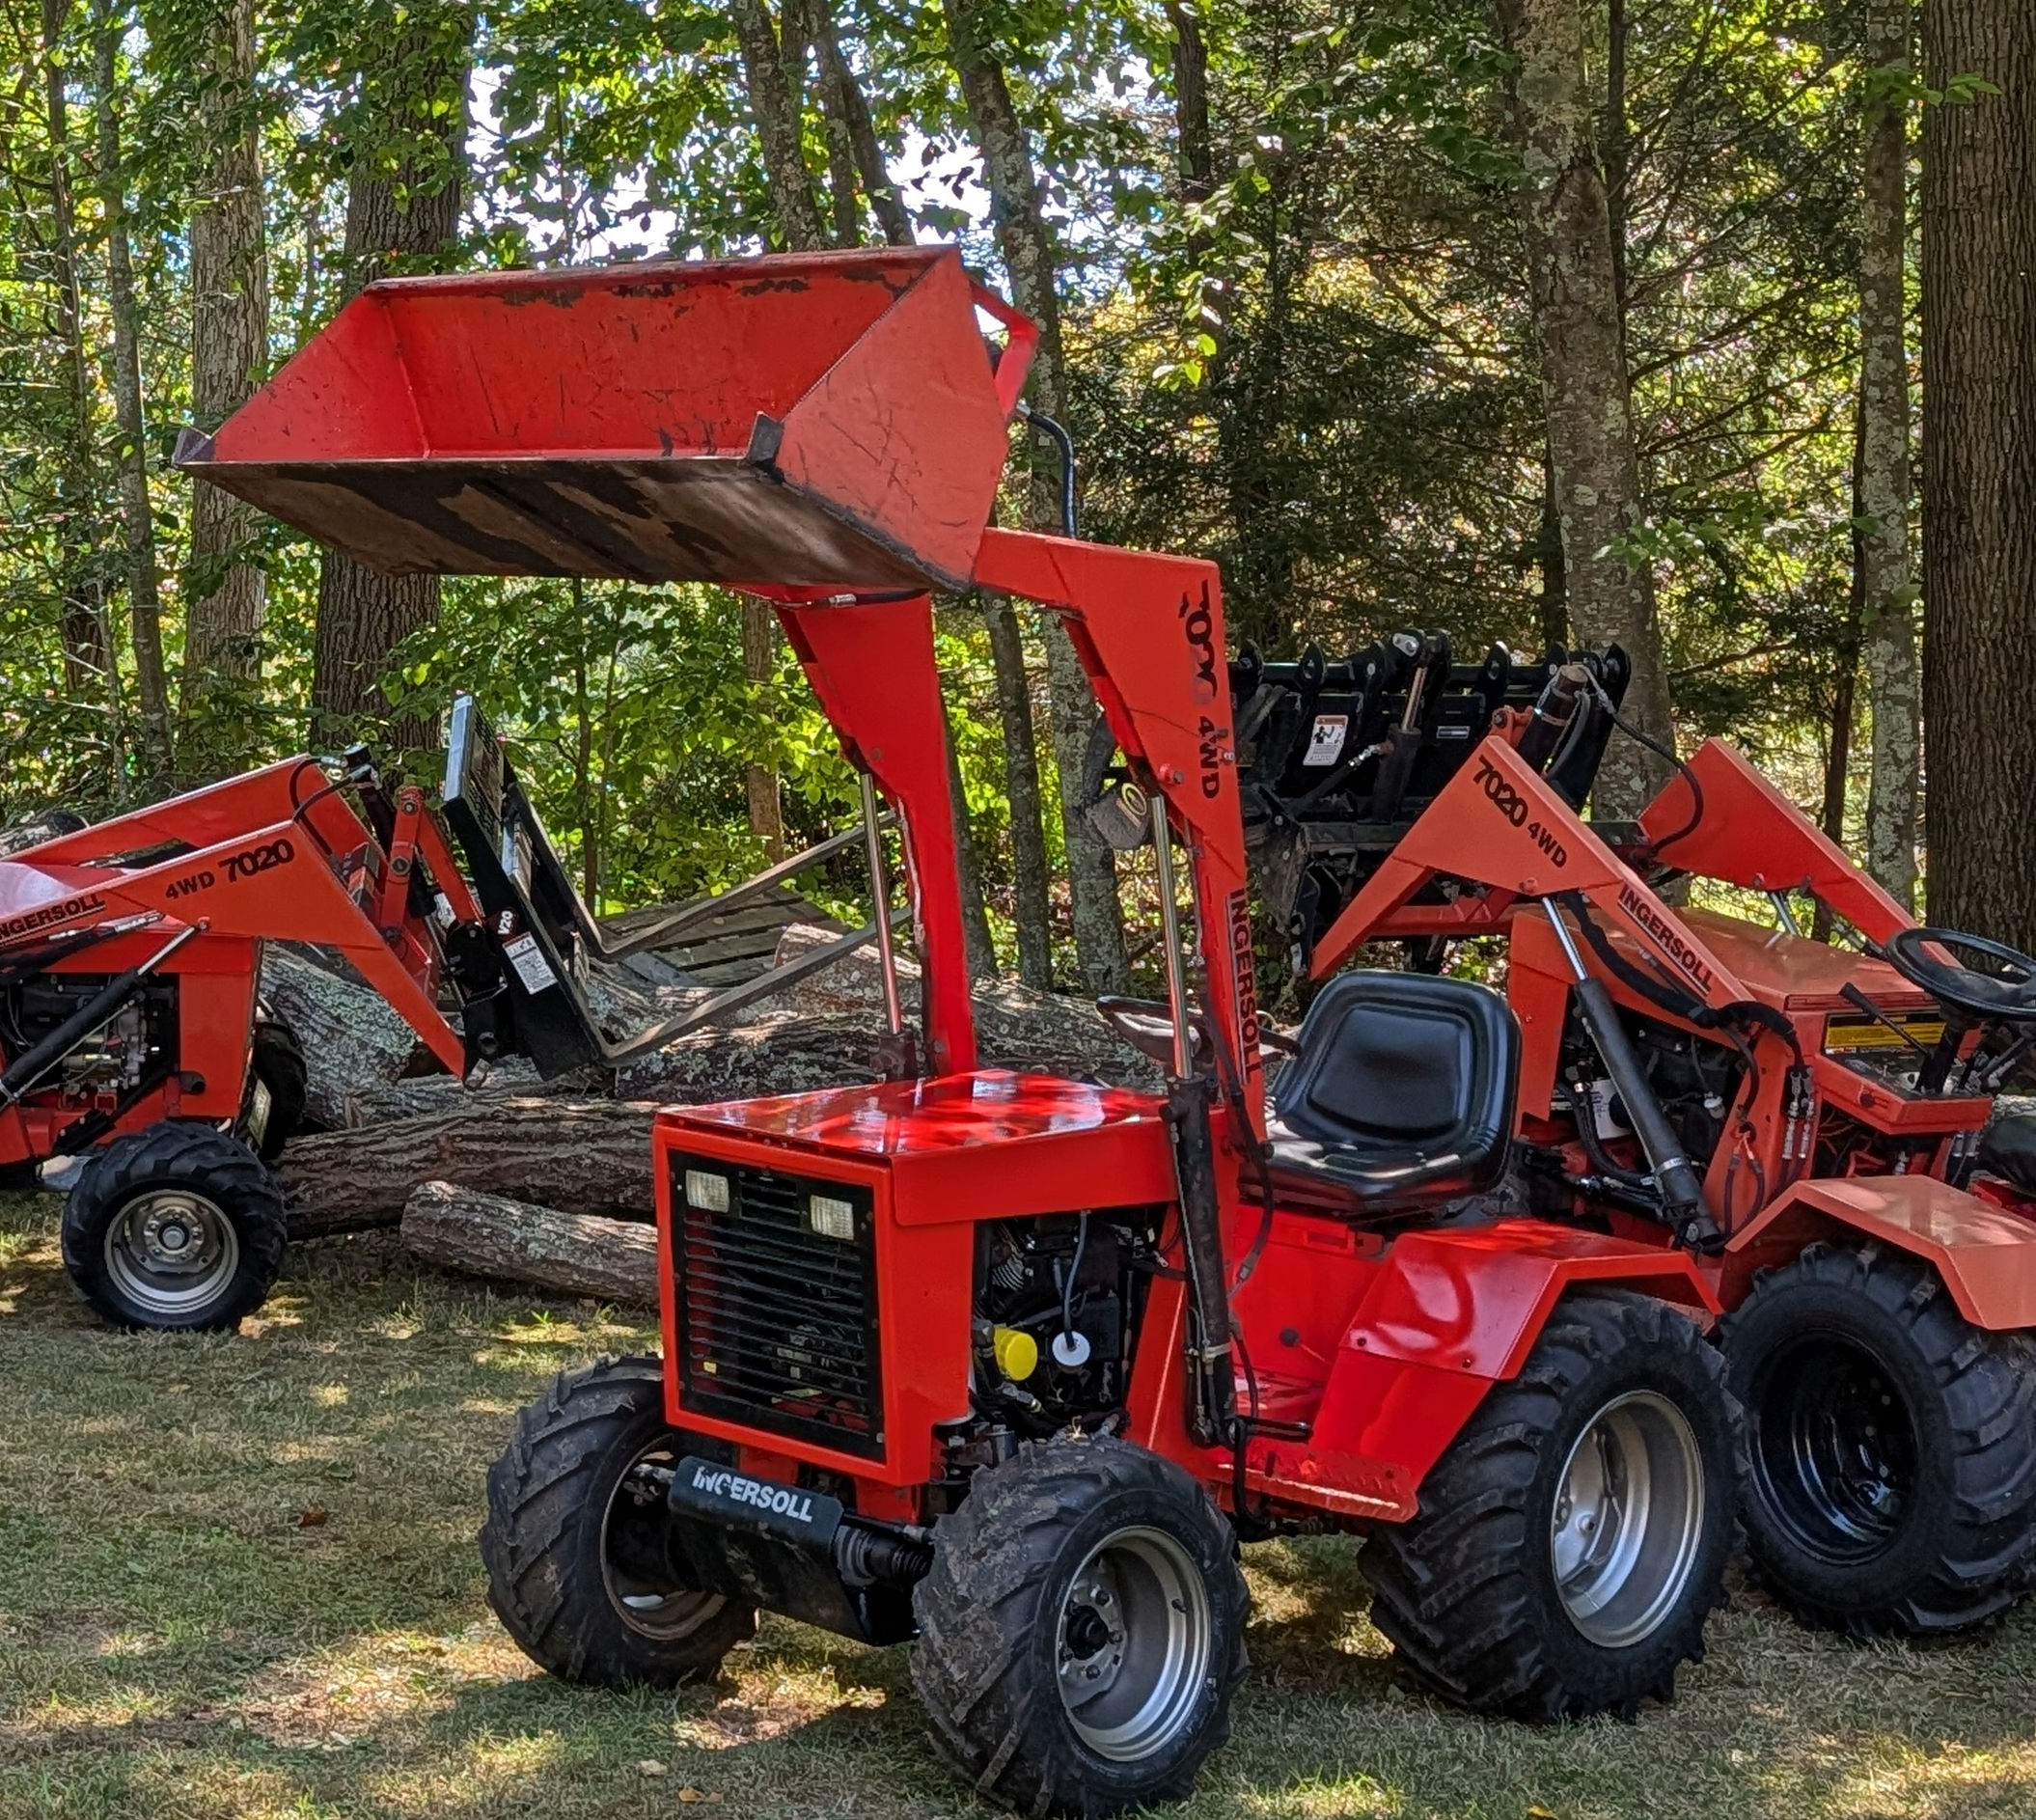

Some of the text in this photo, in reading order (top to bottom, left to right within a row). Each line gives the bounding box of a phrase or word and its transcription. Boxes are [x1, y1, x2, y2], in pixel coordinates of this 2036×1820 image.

[1198, 716, 1220, 798] 4WD
[1472, 755, 1567, 868] 7020 4WD
[165, 838, 294, 899] 4WD 7020
[0, 894, 105, 941] NGERSOLL
[497, 910, 514, 935] V20
[1618, 885, 1714, 992] INGERSOLL
[1228, 887, 1260, 1078] INGERSOLL
[692, 1466, 813, 1523] INGERSOLL
